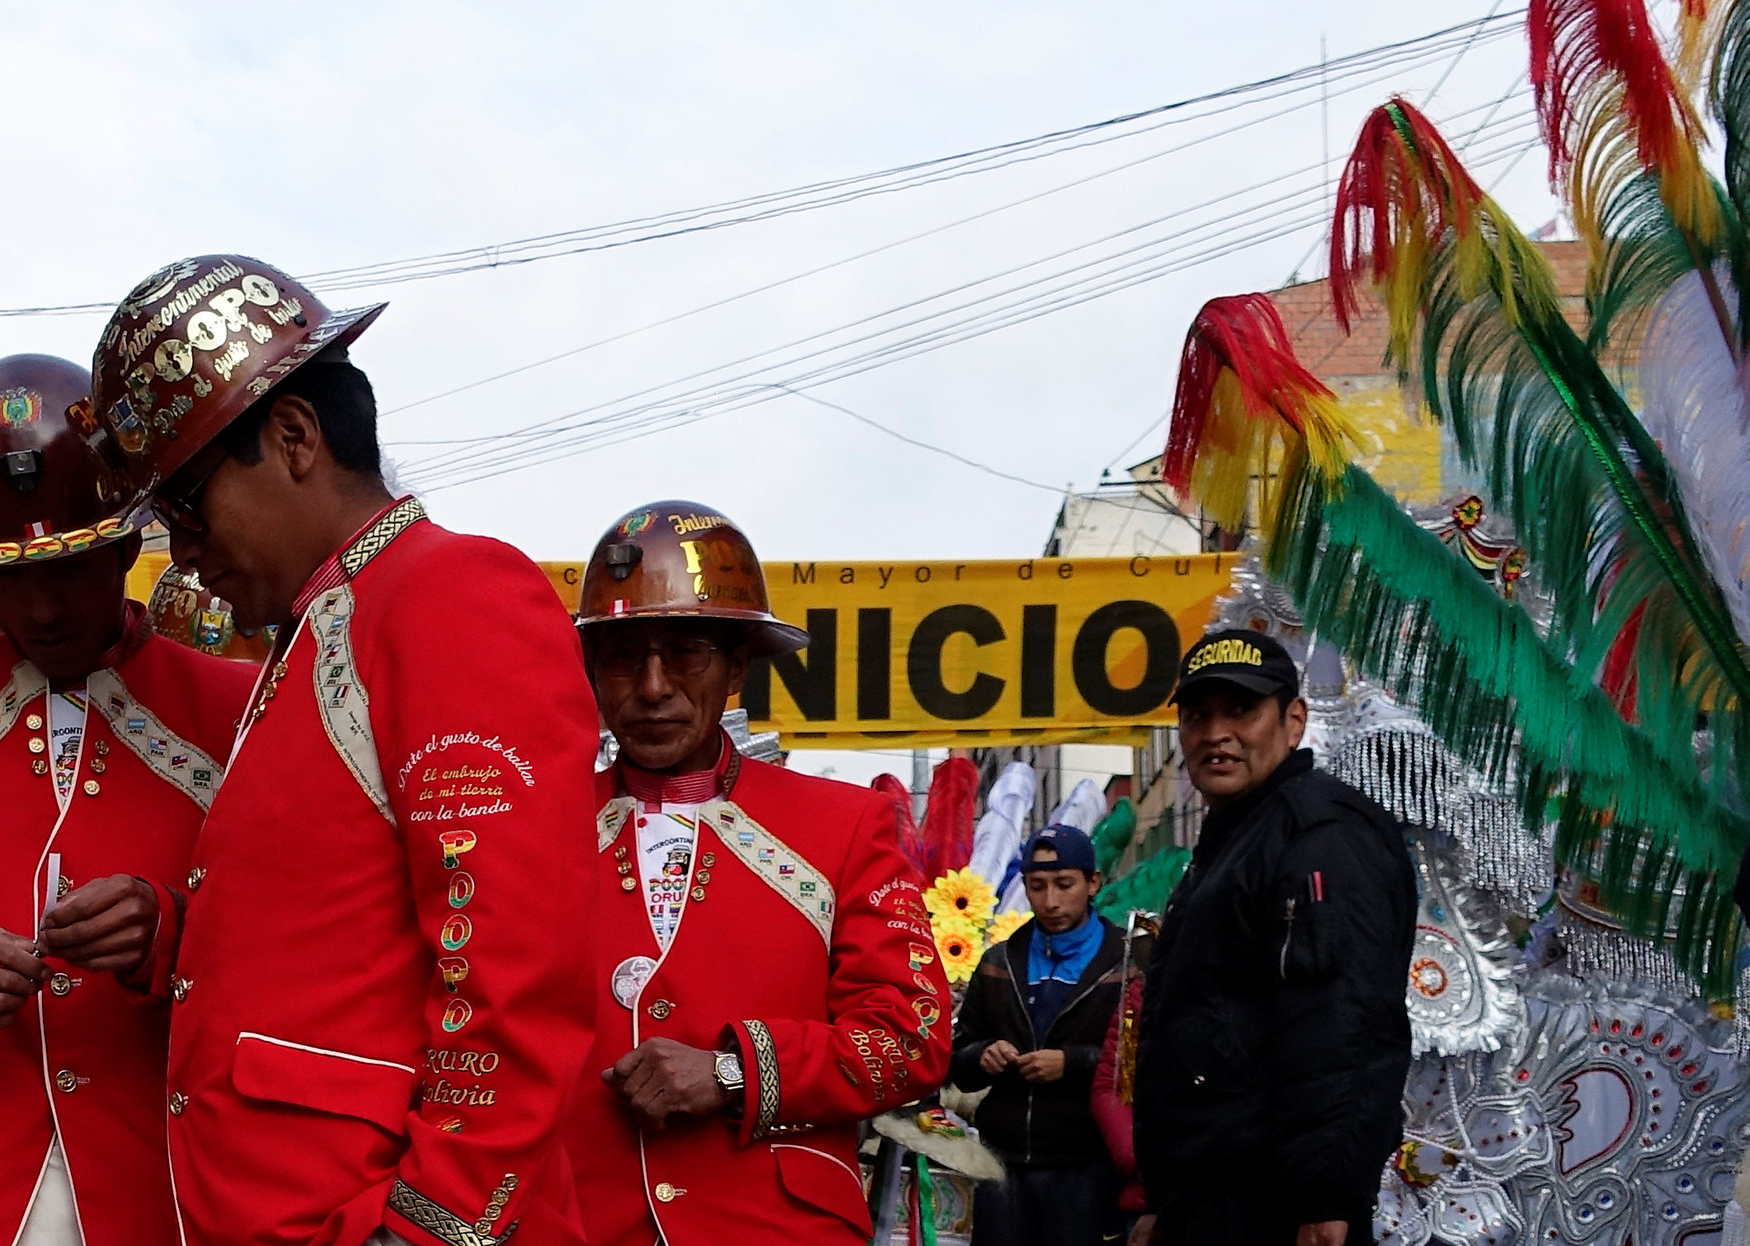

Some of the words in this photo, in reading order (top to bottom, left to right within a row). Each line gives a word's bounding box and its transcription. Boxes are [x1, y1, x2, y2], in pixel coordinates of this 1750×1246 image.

[793, 562, 966, 589] Mayor
[1017, 559, 1074, 581] de
[1188, 639, 1263, 675] SEGURIDAD
[425, 734, 439, 753] el
[439, 731, 481, 752] gusto
[481, 735, 503, 752] de
[502, 747, 536, 787] bailar
[422, 768, 437, 782] El
[441, 765, 502, 783] embrujo
[419, 788, 434, 801] de
[438, 784, 455, 798] mi
[460, 783, 503, 797] tierra
[410, 810, 435, 821] con
[436, 805, 453, 820] la
[458, 799, 513, 818] banda
[438, 830, 478, 1032] POOPO
[423, 1049, 499, 1077] RURO
